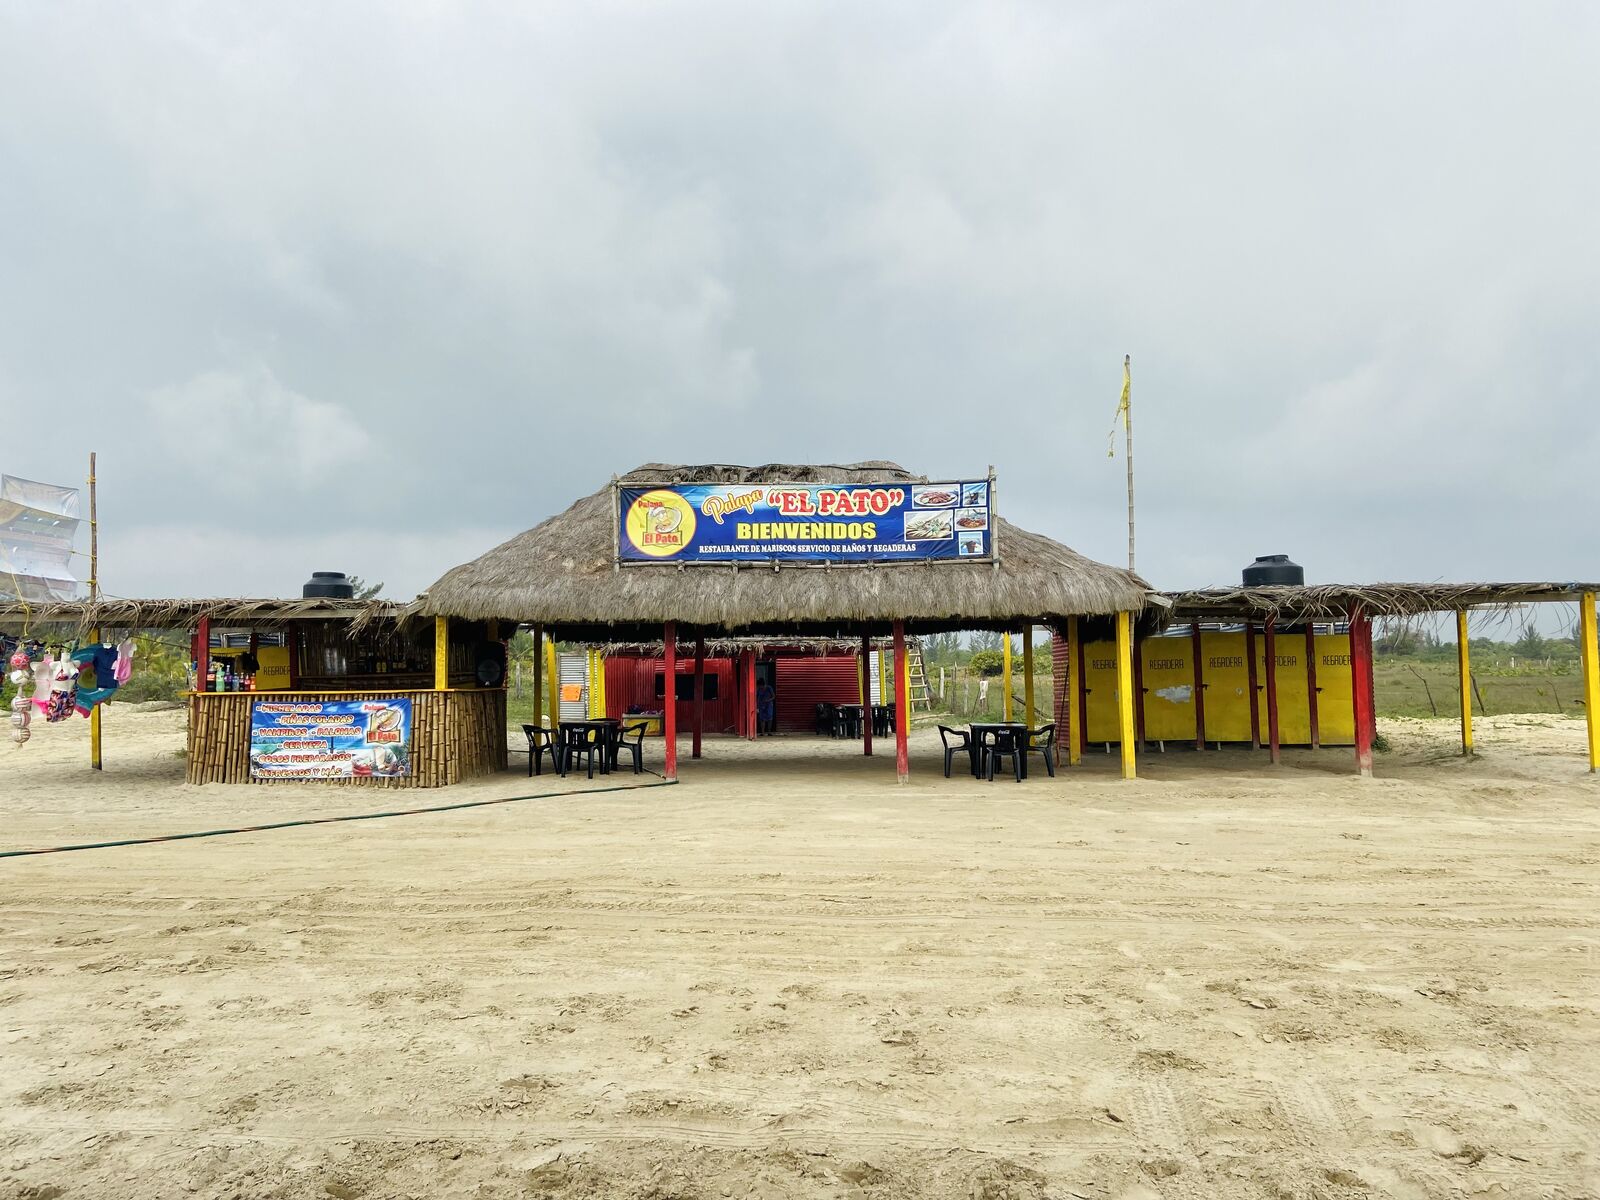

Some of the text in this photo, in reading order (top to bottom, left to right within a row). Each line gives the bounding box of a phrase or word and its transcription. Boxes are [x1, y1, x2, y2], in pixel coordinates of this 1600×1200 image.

[702, 489, 764, 524] Palapa
[736, 522, 877, 540] BIENVENIDOS
[644, 533, 679, 543] El Pato
[699, 545, 749, 553] RESTAURANTE
[750, 545, 760, 553] DE
[761, 545, 796, 553] MARISCOS
[797, 544, 830, 553] SERVICIO
[842, 543, 866, 553] BAÑOS
[873, 544, 916, 552] REGADERAS
[1149, 659, 1184, 670] REGADERA
[1209, 657, 1242, 667] REGADERA
[311, 716, 354, 724] COLADAS
